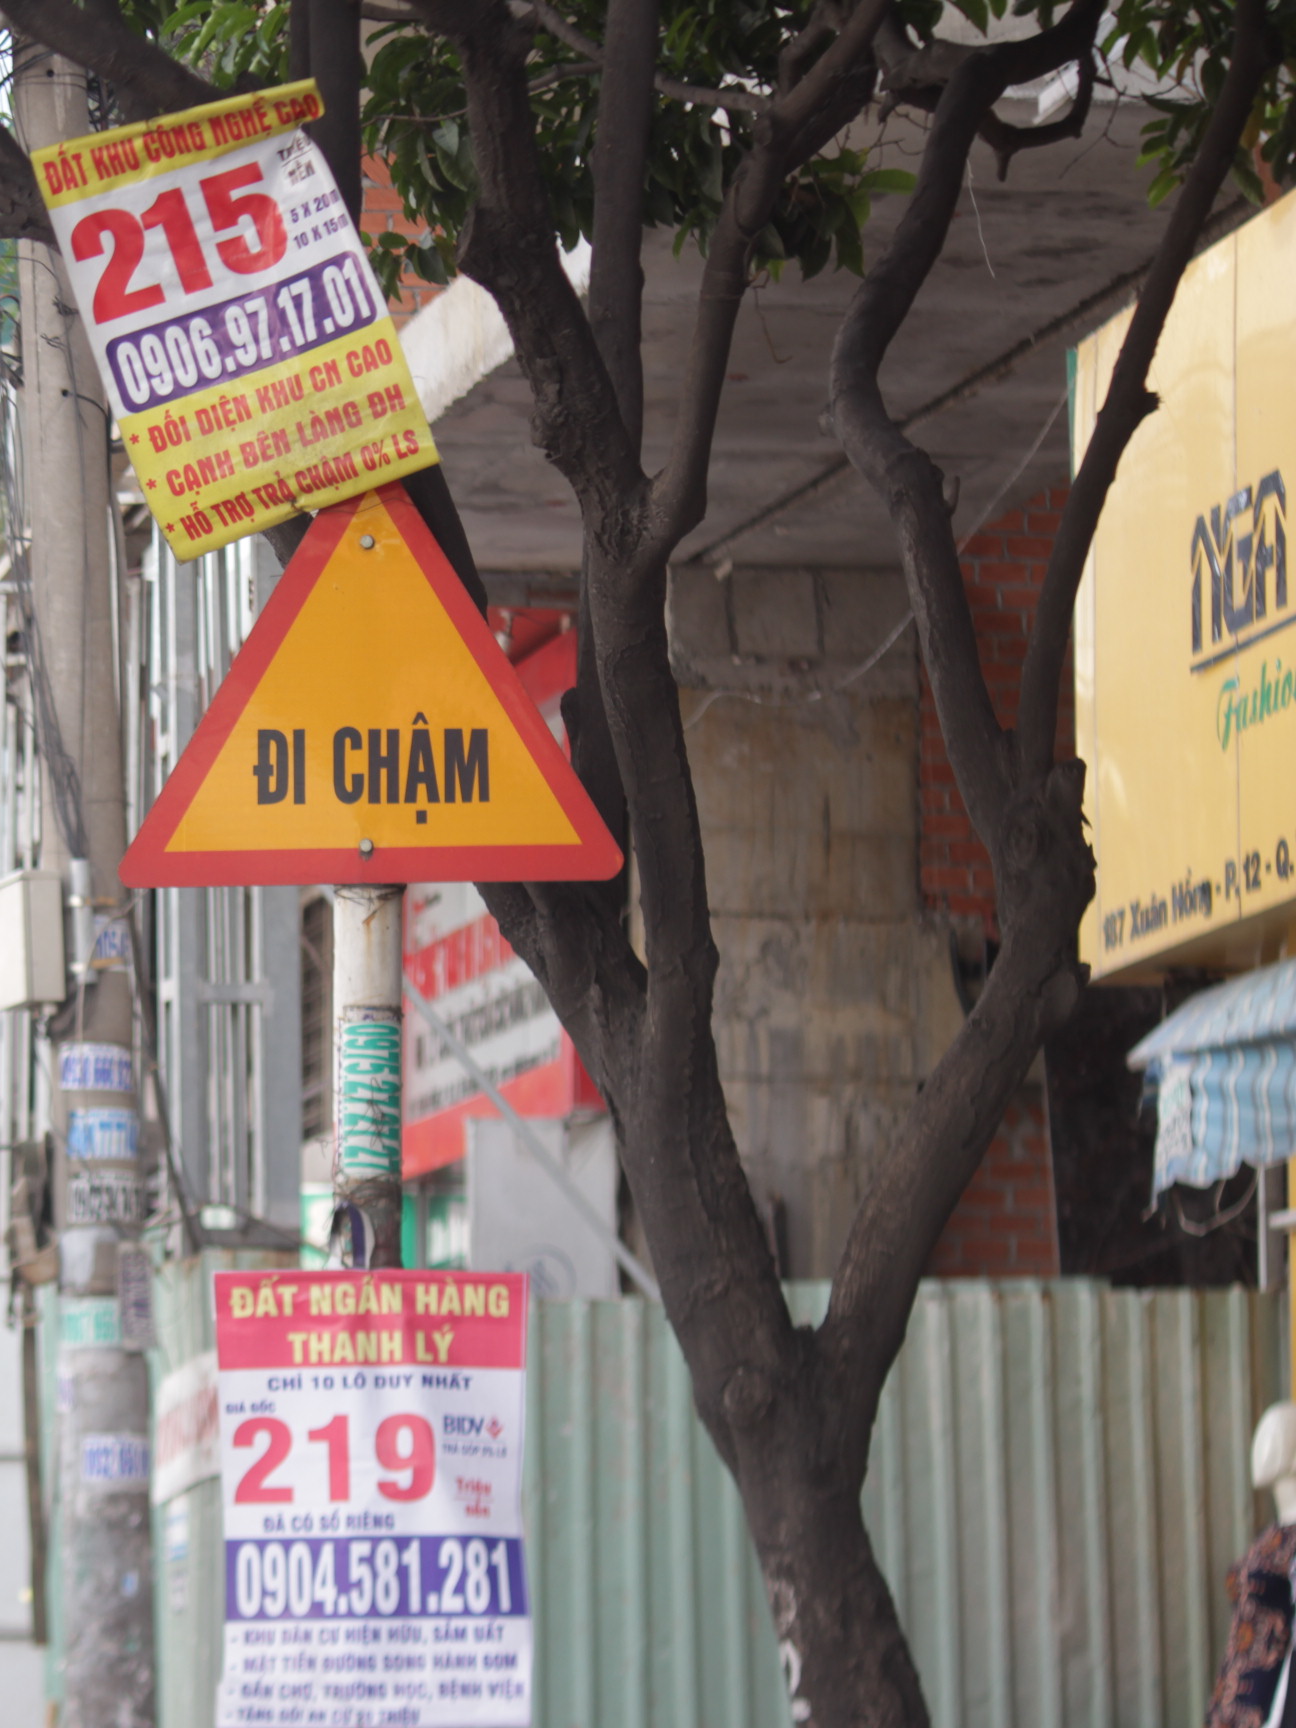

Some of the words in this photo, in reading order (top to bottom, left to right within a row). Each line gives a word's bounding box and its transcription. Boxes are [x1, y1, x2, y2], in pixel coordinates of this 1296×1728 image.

[43, 143, 88, 195] ĐẤT
[90, 138, 141, 180] KHU
[143, 120, 207, 163] CÔNG
[208, 97, 272, 146] NGHỆ
[274, 93, 320, 126] CAO
[71, 162, 288, 324] 215
[290, 208, 299, 223] 5
[293, 231, 309, 249] 10
[116, 256, 373, 406] 0906.97.17.01
[148, 410, 192, 453] ĐỐI
[195, 394, 252, 436] DIỆN
[256, 374, 305, 415] KHU
[309, 359, 342, 393] CN
[345, 338, 393, 378] CAO
[166, 449, 236, 497] CẠNH
[239, 427, 292, 470] BÊN
[296, 400, 363, 447] LÀNG
[366, 383, 407, 420] ĐH
[180, 501, 214, 541] HỖ
[210, 492, 255, 525] TRỢ
[251, 471, 296, 510] TRẢ
[294, 452, 359, 495] CHẬM
[362, 439, 391, 473] 0%
[392, 428, 420, 460] LS
[1190, 468, 1288, 656] NGA
[1216, 655, 1296, 753] Fashio
[253, 728, 305, 805] ĐI
[332, 711, 490, 824] CHẬM
[1243, 851, 1261, 892] 12
[230, 1276, 298, 1318] ĐẤT
[310, 1276, 403, 1316] NGÂN
[415, 1277, 509, 1318] HÀNG
[287, 1330, 403, 1364] THANH
[415, 1323, 453, 1363] LÝ
[267, 1373, 303, 1392] CHỈ
[311, 1376, 334, 1391] 10
[342, 1372, 366, 1390] LÔ
[374, 1374, 413, 1390] DUY
[421, 1370, 473, 1391] NHẤT
[442, 1414, 484, 1437] BIDV
[232, 1412, 437, 1505] 219
[346, 1511, 395, 1530] RIÊNG
[235, 1537, 512, 1618] 0904.581.281
